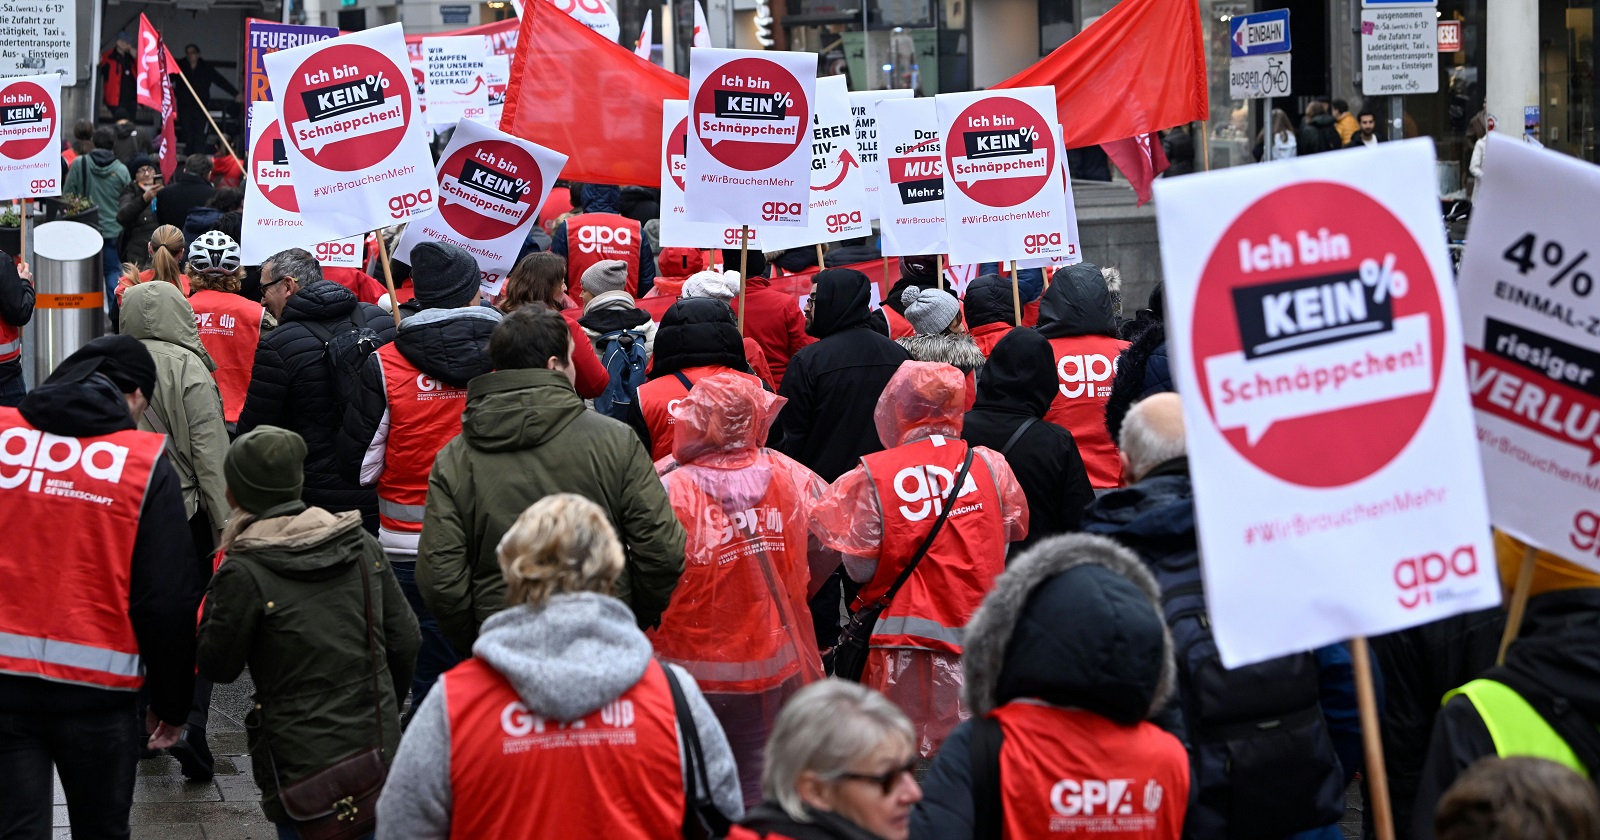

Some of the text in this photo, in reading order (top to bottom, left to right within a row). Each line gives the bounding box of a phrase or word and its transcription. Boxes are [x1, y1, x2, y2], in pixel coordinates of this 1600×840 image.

[12, 16, 40, 24] Zufahrt
[1377, 12, 1422, 20] ausgenommen
[1249, 24, 1281, 43] EINBAHN
[28, 50, 69, 60] Einsteigen
[1366, 53, 1433, 61] Behindertentransporte
[1402, 62, 1432, 70] Einsteigen
[304, 65, 359, 86] Ich bin
[721, 75, 770, 89] Ich bin
[4, 94, 32, 103] Ich bin
[464, 108, 484, 118] gpa
[299, 106, 401, 141] Schnäppchen!
[702, 121, 795, 136] Schnäppchen!
[855, 117, 876, 128] ÄMP
[968, 115, 1014, 128] Ich bin
[813, 124, 851, 140] EREN
[855, 129, 876, 139] ÜR U
[915, 130, 938, 139] Dar
[812, 142, 838, 155] TIV-
[857, 142, 878, 151] OLLE
[895, 142, 940, 153] ein biss
[475, 148, 518, 174] Ich bin
[811, 158, 827, 171] G!
[904, 161, 943, 177] MUS
[956, 157, 1045, 174] Schnäppchen!
[261, 169, 290, 178] Schn
[314, 165, 415, 197] #WirBrauchenMehr
[701, 174, 794, 187] #WirBrauchenMehr
[31, 179, 55, 194] gpa
[908, 187, 934, 197] Mehr
[388, 188, 433, 219] gpa
[442, 181, 523, 218] Schnäppchen!
[809, 199, 837, 208] enMehr
[762, 202, 801, 221] gpa
[962, 210, 1050, 225] #WirBrauchenMehr
[826, 211, 861, 233] gpa
[896, 216, 945, 225] #WirBrauche
[578, 226, 631, 253] gpa
[1024, 233, 1061, 254] gpa
[316, 243, 355, 261] gpa
[1238, 227, 1350, 272] Ich bin
[1502, 232, 1593, 298] 4%
[1495, 280, 1600, 336] EINMAL-Z
[220, 314, 235, 328] djp
[1496, 333, 1594, 385] riesiger
[1058, 354, 1120, 398] gp
[1220, 344, 1425, 405] Schnäppchen!
[1468, 359, 1600, 450] VERLU
[0, 427, 129, 489] gpa
[1476, 425, 1600, 494] WirBrauchenM
[46, 479, 74, 489] MEINE
[894, 463, 978, 521] gpa
[44, 486, 113, 506] GEWERKSCHAFT
[1244, 487, 1446, 546] #WirBrauchenMehr
[1393, 545, 1477, 609] gpa
